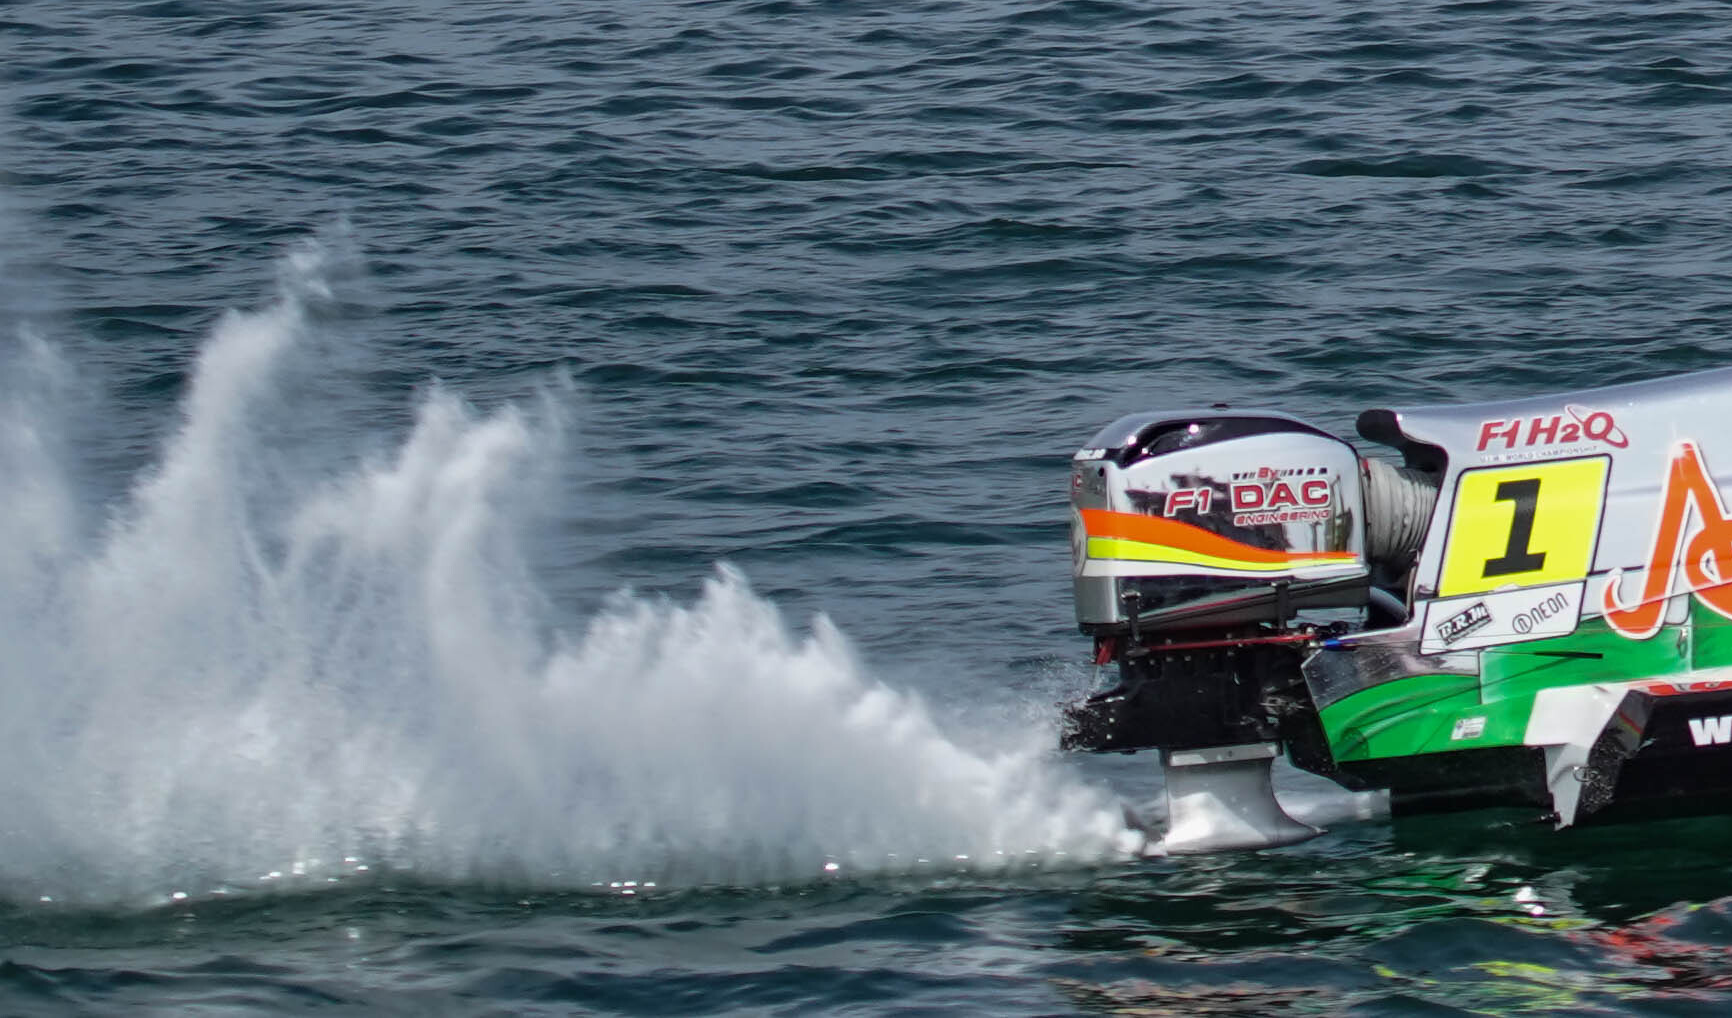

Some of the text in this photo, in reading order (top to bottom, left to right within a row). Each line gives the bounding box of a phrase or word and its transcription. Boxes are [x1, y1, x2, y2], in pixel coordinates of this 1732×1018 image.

[1165, 478, 1331, 517] F1 DAC
[1233, 509, 1331, 526] ENGINEERING
[1481, 478, 1547, 578] 1
